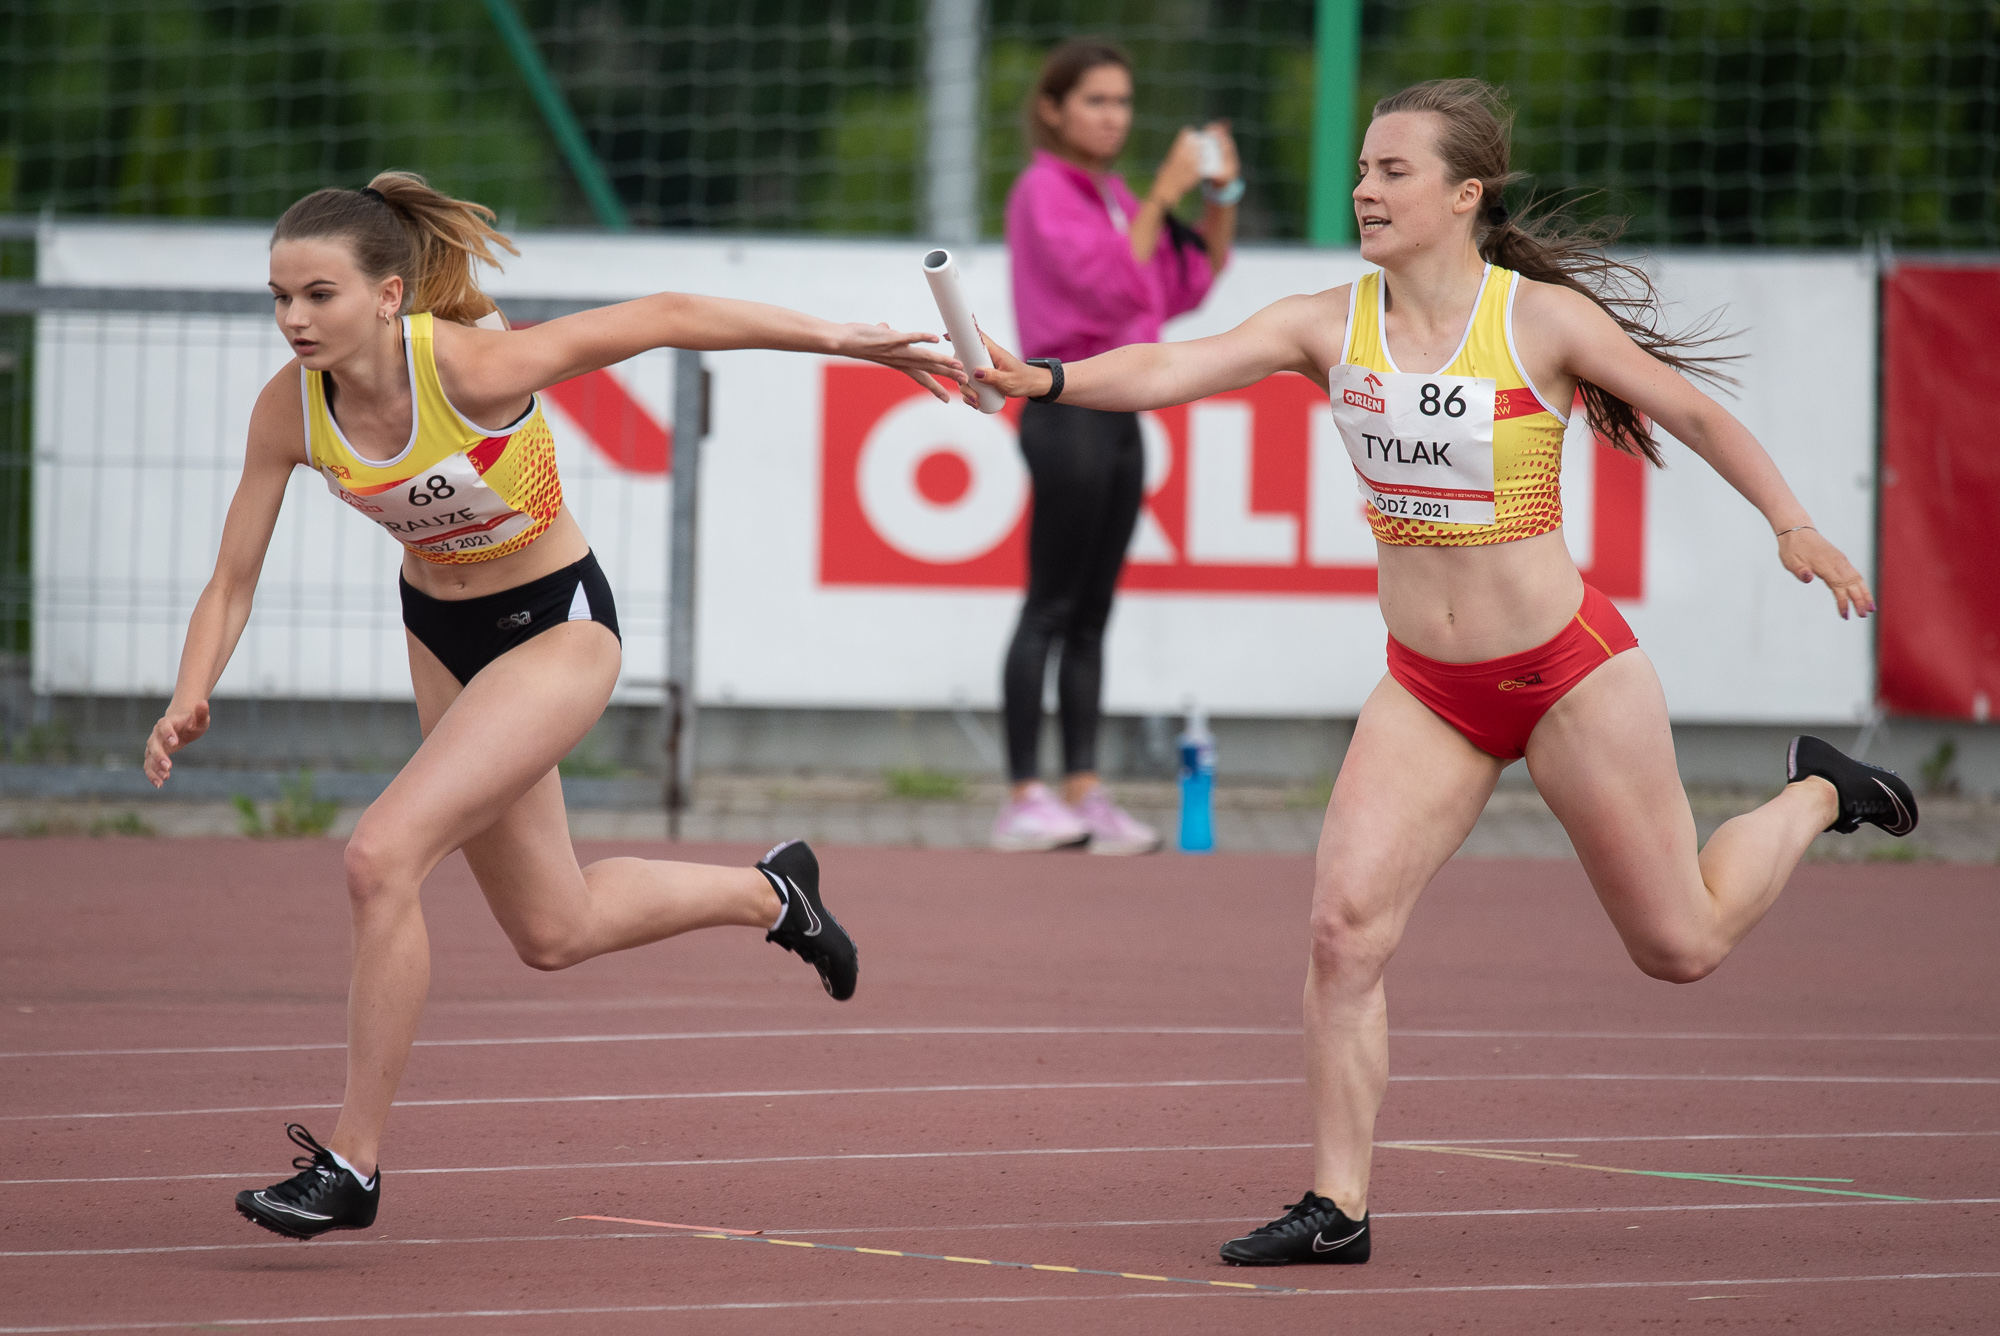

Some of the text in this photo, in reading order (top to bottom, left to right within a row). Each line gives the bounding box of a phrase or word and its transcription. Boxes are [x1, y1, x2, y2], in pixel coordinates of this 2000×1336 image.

[1344, 391, 1383, 413] ORLEN
[1419, 383, 1467, 418] 86
[1361, 432, 1453, 467] TYLAK
[327, 466, 352, 480] sa
[856, 393, 1594, 569] OLE
[408, 474, 455, 507] 68
[376, 507, 479, 534] RAUZE
[1412, 501, 1449, 518] 2021
[455, 534, 494, 550] 2021
[497, 611, 532, 630] esa
[1498, 673, 1543, 691] esa
